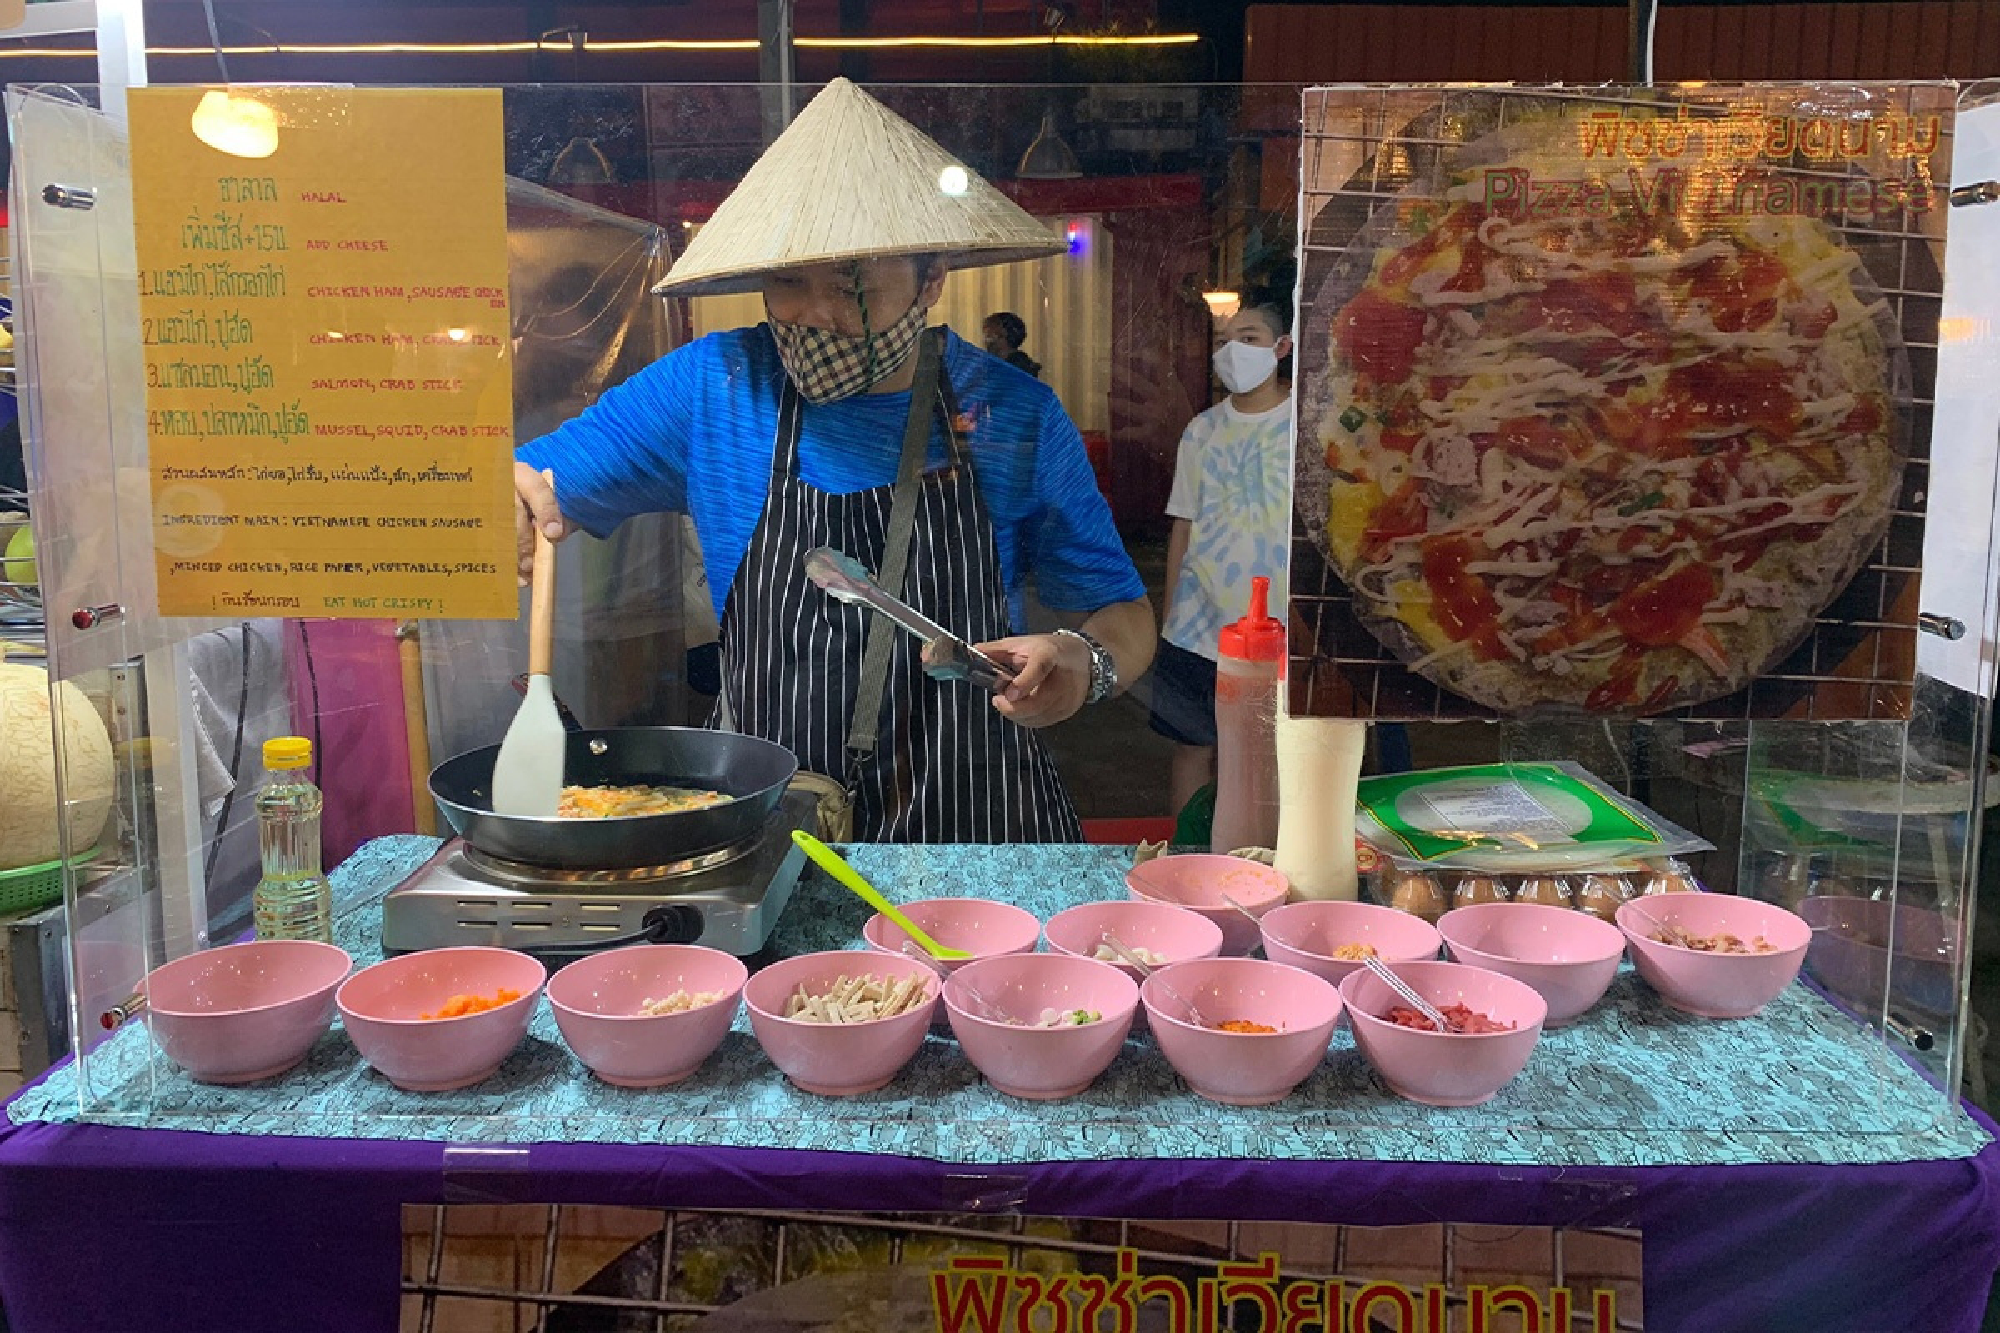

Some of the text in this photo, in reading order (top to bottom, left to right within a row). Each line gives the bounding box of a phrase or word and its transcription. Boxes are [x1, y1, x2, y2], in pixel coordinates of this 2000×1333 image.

[302, 191, 347, 203] HALAL
[1485, 167, 1611, 214] Pizza
[306, 239, 389, 252] ADD CHEESE
[307, 286, 371, 298] CHICKEN
[379, 378, 416, 391] CRAB
[422, 378, 463, 391] STICK
[431, 424, 468, 437] CRAB
[471, 424, 510, 438] STICK
[291, 515, 371, 528] VIETNAMESE
[376, 516, 427, 528] CHICKEN
[431, 516, 484, 528] SAUSAGE
[323, 596, 346, 608] EAT
